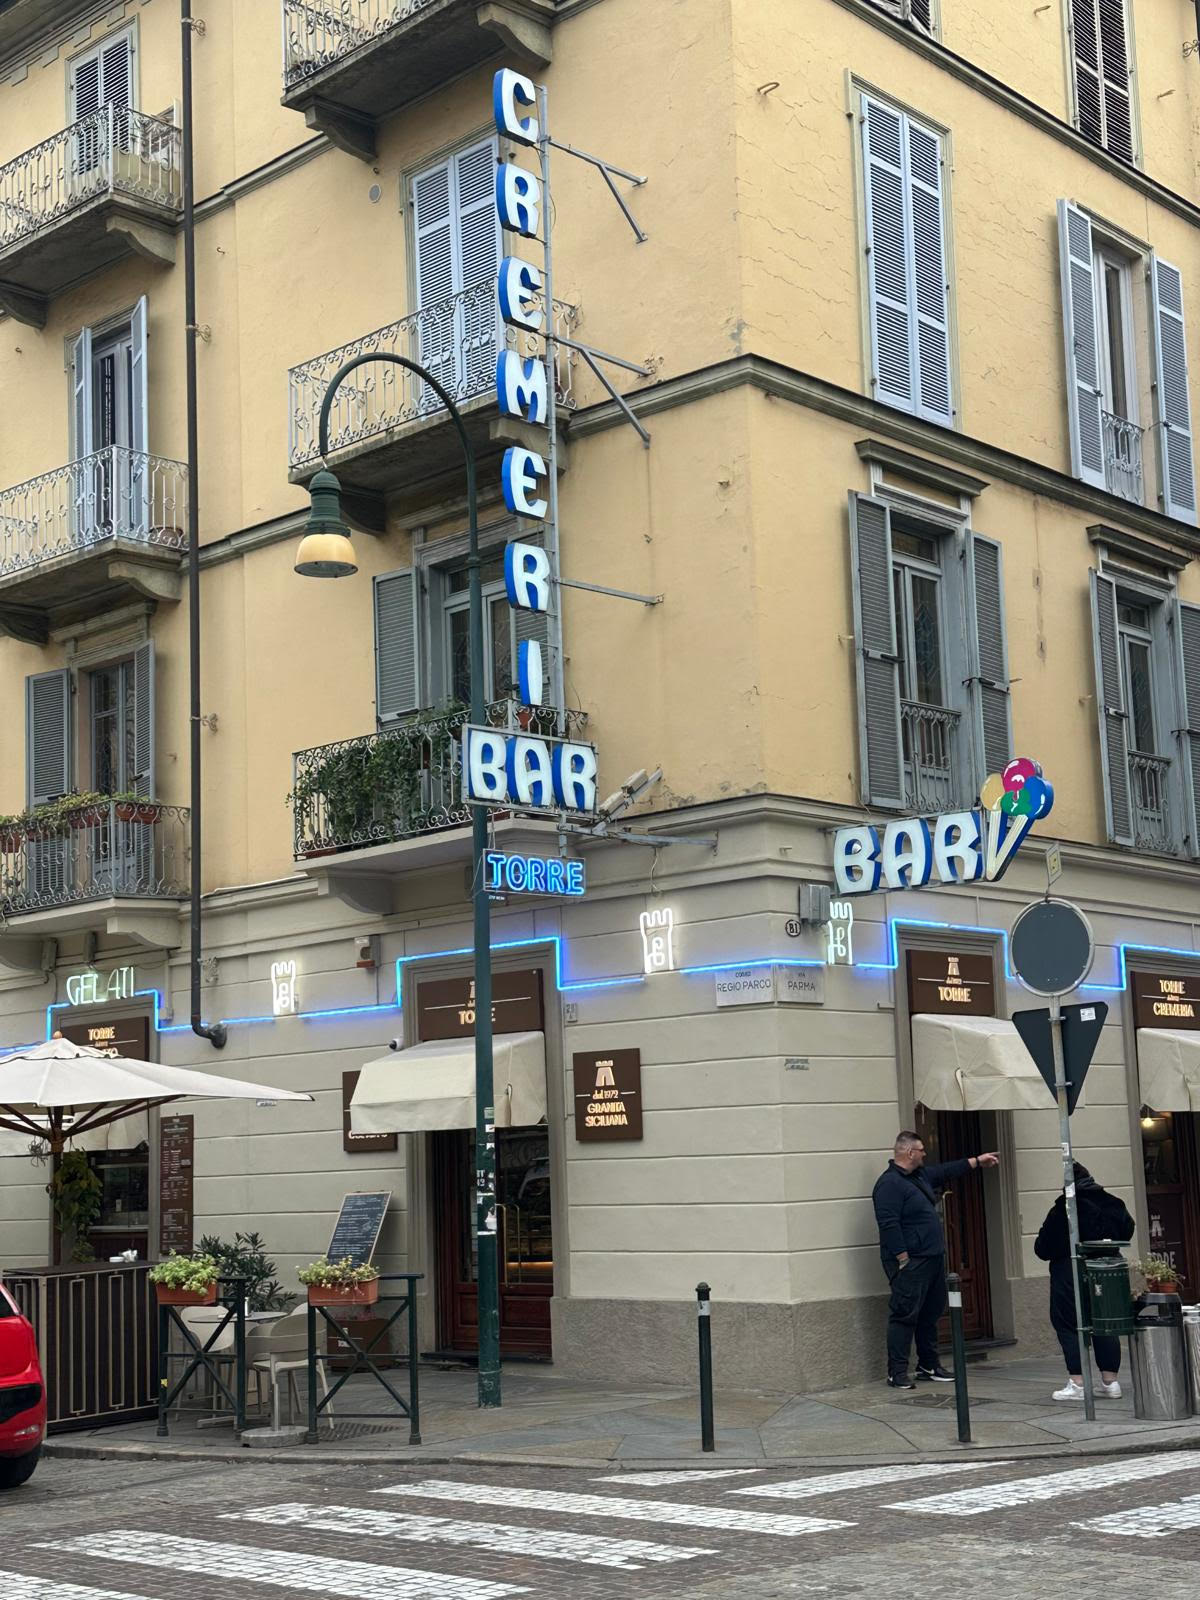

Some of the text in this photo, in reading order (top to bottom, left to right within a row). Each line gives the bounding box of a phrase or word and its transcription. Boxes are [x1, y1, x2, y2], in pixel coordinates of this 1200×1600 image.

[493, 67, 548, 706] CREMERI
[468, 729, 597, 812] BAR
[833, 810, 984, 894] BAR
[486, 853, 585, 895] TORRE
[66, 967, 134, 1005] GELATI
[717, 978, 771, 993] REGIO PARCO
[787, 980, 816, 992] PARMA
[1159, 979, 1186, 994] TORRE
[938, 986, 972, 1002] TORRE
[458, 1007, 496, 1025] TOE
[88, 1027, 115, 1040] TORRE
[587, 1101, 626, 1114] GRANITA
[585, 1114, 628, 1127] SICILIANA
